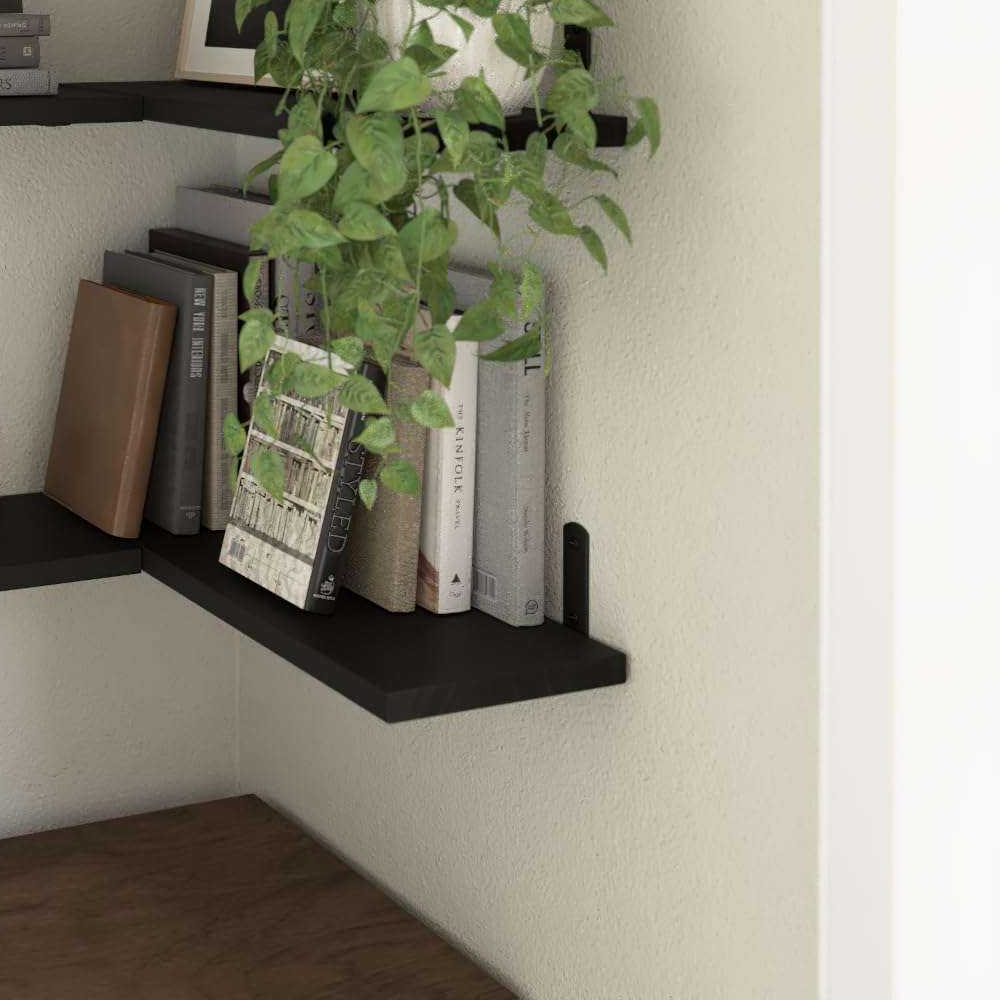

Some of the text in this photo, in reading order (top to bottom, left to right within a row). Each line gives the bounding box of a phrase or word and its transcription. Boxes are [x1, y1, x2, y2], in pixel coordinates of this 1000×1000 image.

[189, 287, 207, 378] NEW YORK INTERIORS
[328, 439, 366, 553] STYLED
[453, 426, 465, 493] KINFOLK
